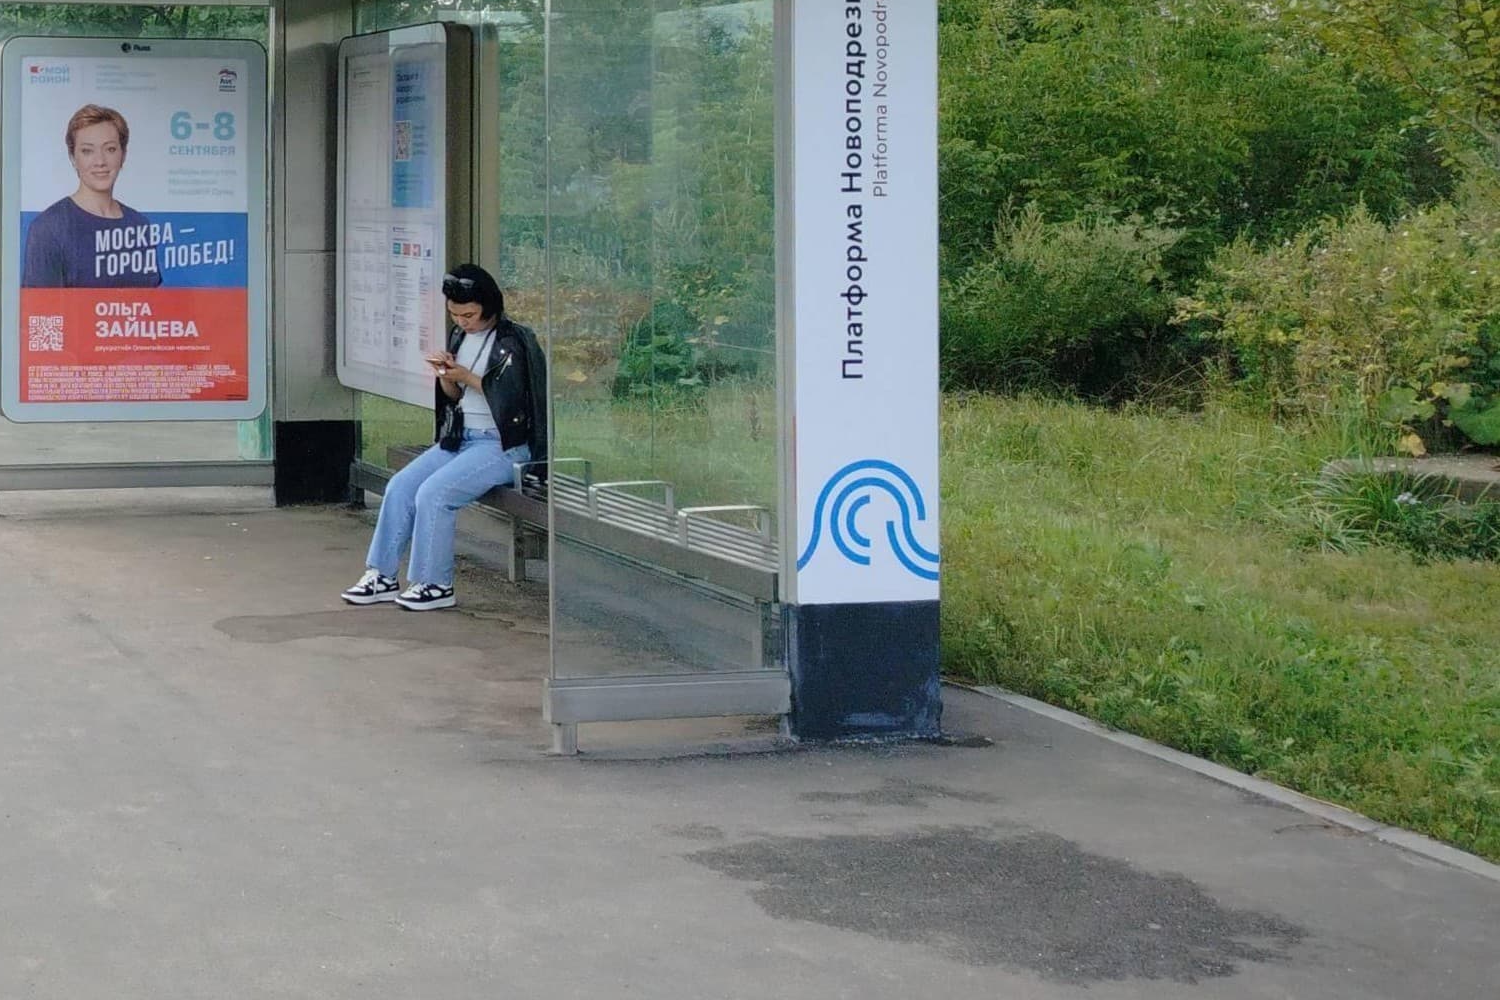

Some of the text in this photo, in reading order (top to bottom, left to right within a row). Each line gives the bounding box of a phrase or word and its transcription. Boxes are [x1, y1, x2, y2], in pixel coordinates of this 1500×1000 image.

[169, 145, 236, 156] СЕНТЯБРЯ
[872, 105, 888, 198] Platforma
[95, 222, 174, 253] МОСКВА
[95, 239, 235, 278] ГОРОД ПОБЕД!
[840, 204, 868, 380] Платформа
[95, 302, 152, 317] ОЛЬГА
[95, 316, 199, 340] ЗАЙЦЕВА
